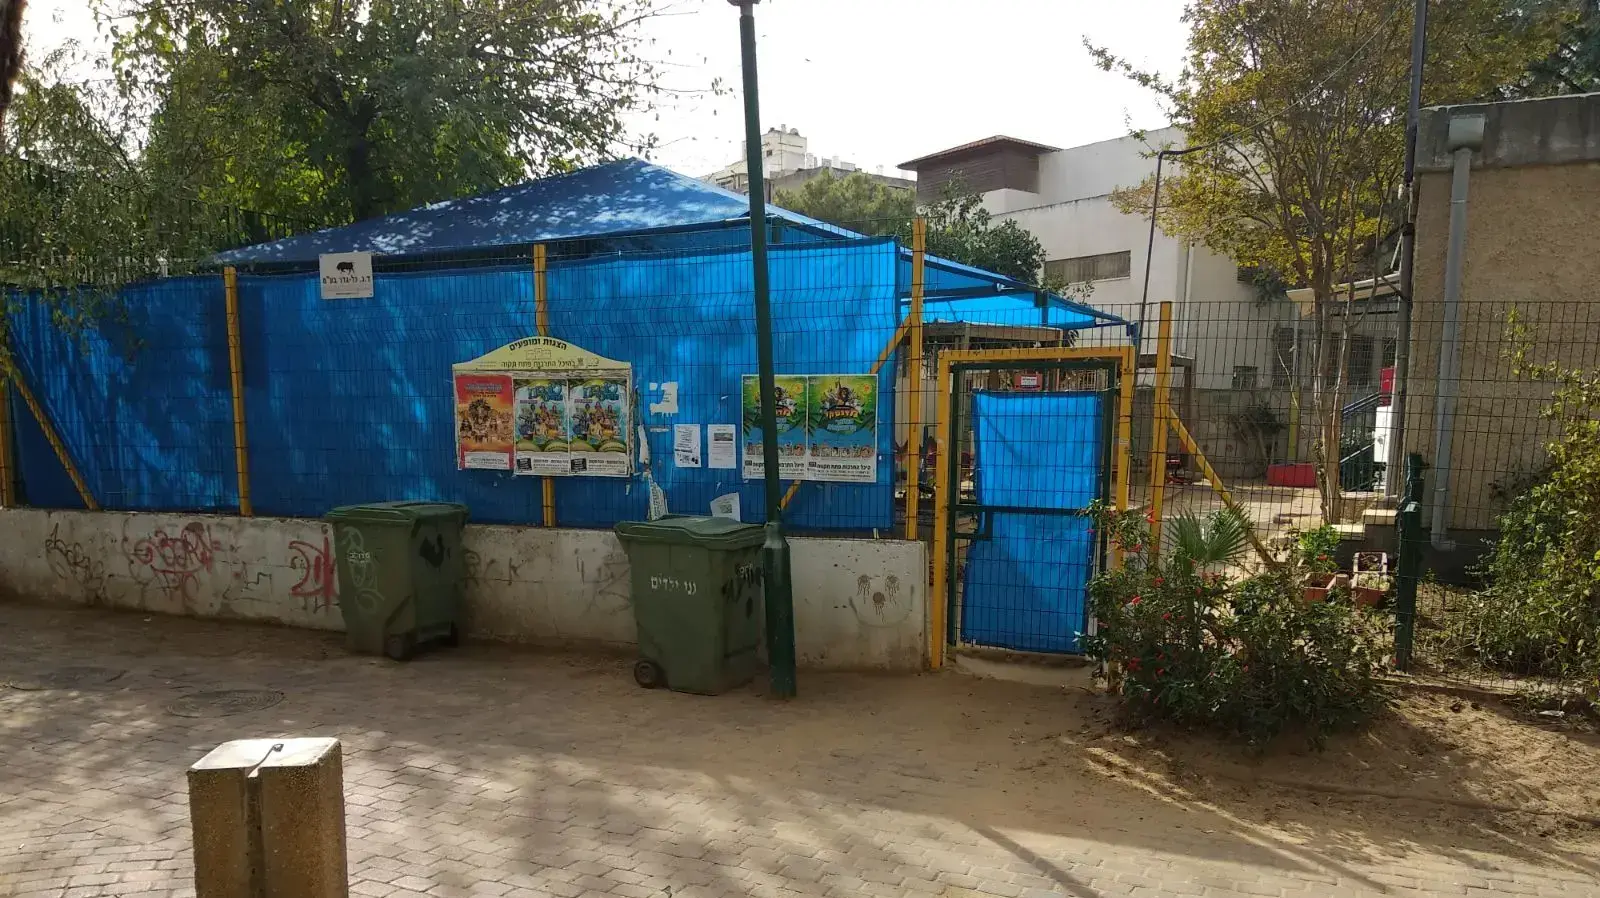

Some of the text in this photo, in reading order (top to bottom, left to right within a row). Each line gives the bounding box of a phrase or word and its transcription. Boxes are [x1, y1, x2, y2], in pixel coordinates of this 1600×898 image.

[509, 338, 567, 351] הצגות ומופעים
[533, 360, 556, 368] התרבות
[558, 359, 576, 367] בהיכל
